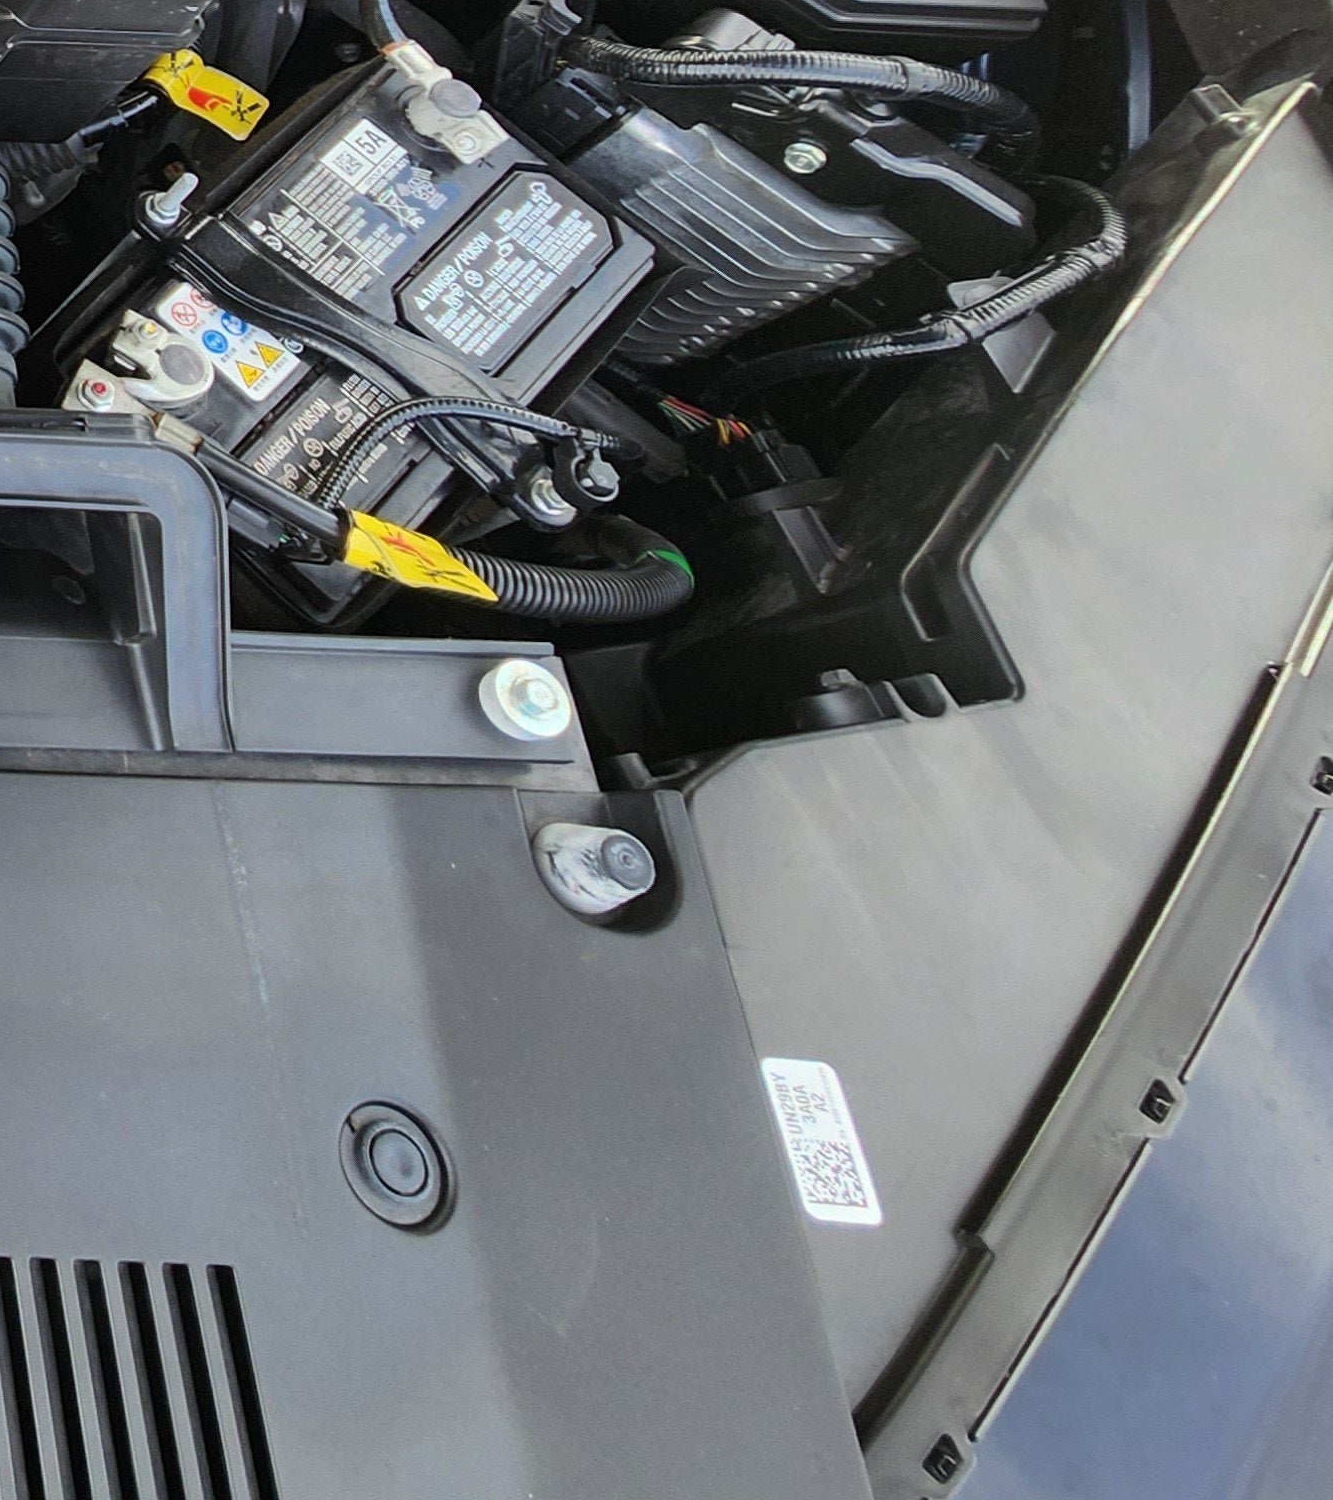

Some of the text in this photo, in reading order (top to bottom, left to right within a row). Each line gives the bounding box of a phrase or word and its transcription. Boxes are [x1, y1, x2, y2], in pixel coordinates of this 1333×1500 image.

[354, 127, 387, 155] 5A
[422, 231, 492, 301] DANGER/POISON
[251, 396, 331, 476] DANGER/POISON
[811, 1093, 828, 1112] A2
